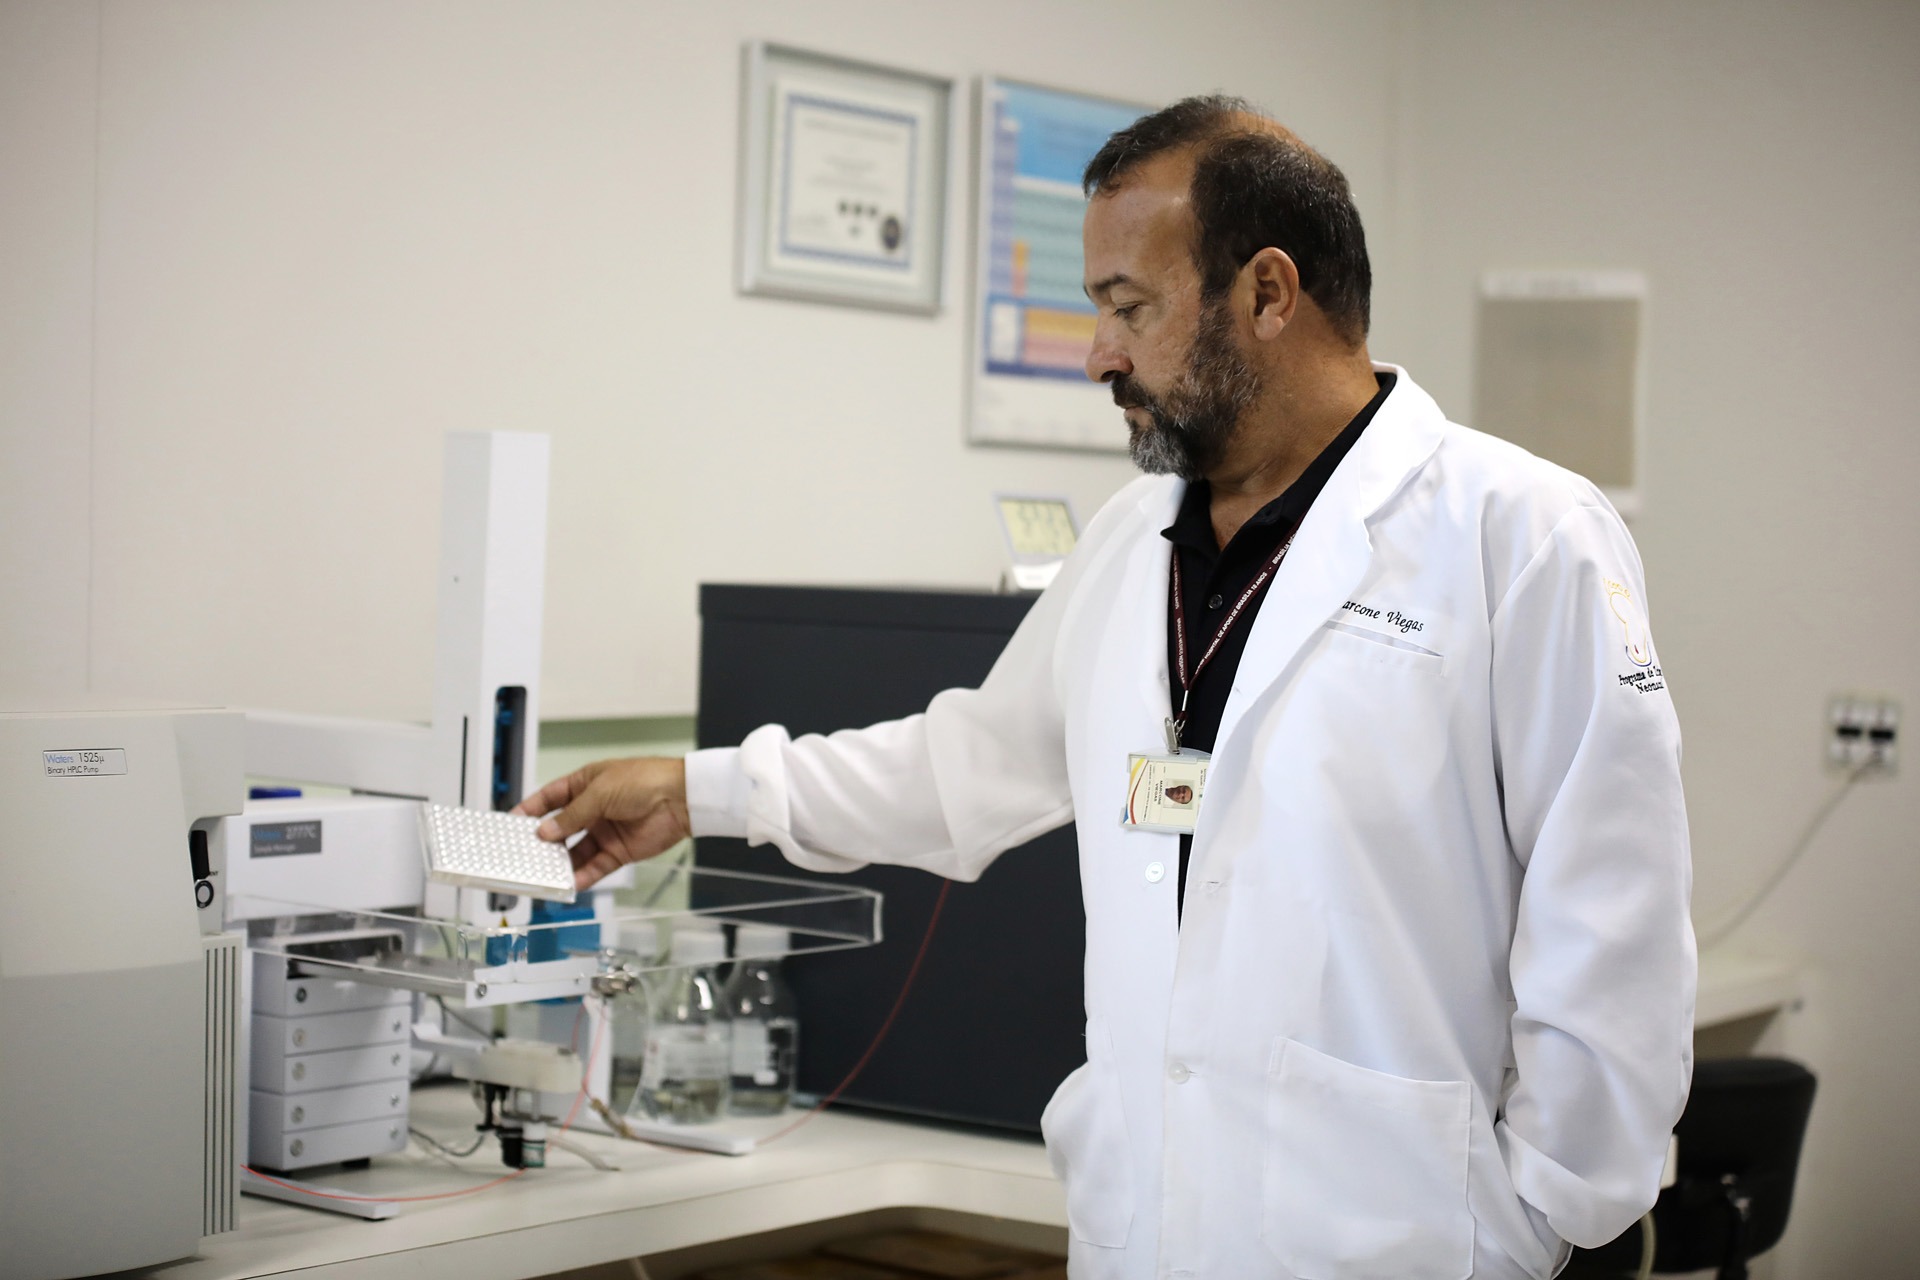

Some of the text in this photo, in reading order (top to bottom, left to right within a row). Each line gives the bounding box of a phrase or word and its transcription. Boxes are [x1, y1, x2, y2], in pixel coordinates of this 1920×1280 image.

[1204, 638, 1221, 660] HOSPITAL
[1217, 629, 1225, 638] DE
[1222, 615, 1234, 631] APOIO
[1231, 608, 1239, 617] DE
[1255, 571, 1268, 586] ANOS
[1341, 600, 1424, 633] arcone Viegas
[46, 754, 75, 764] Waters
[47, 765, 99, 774] Binary HPLC Pump
